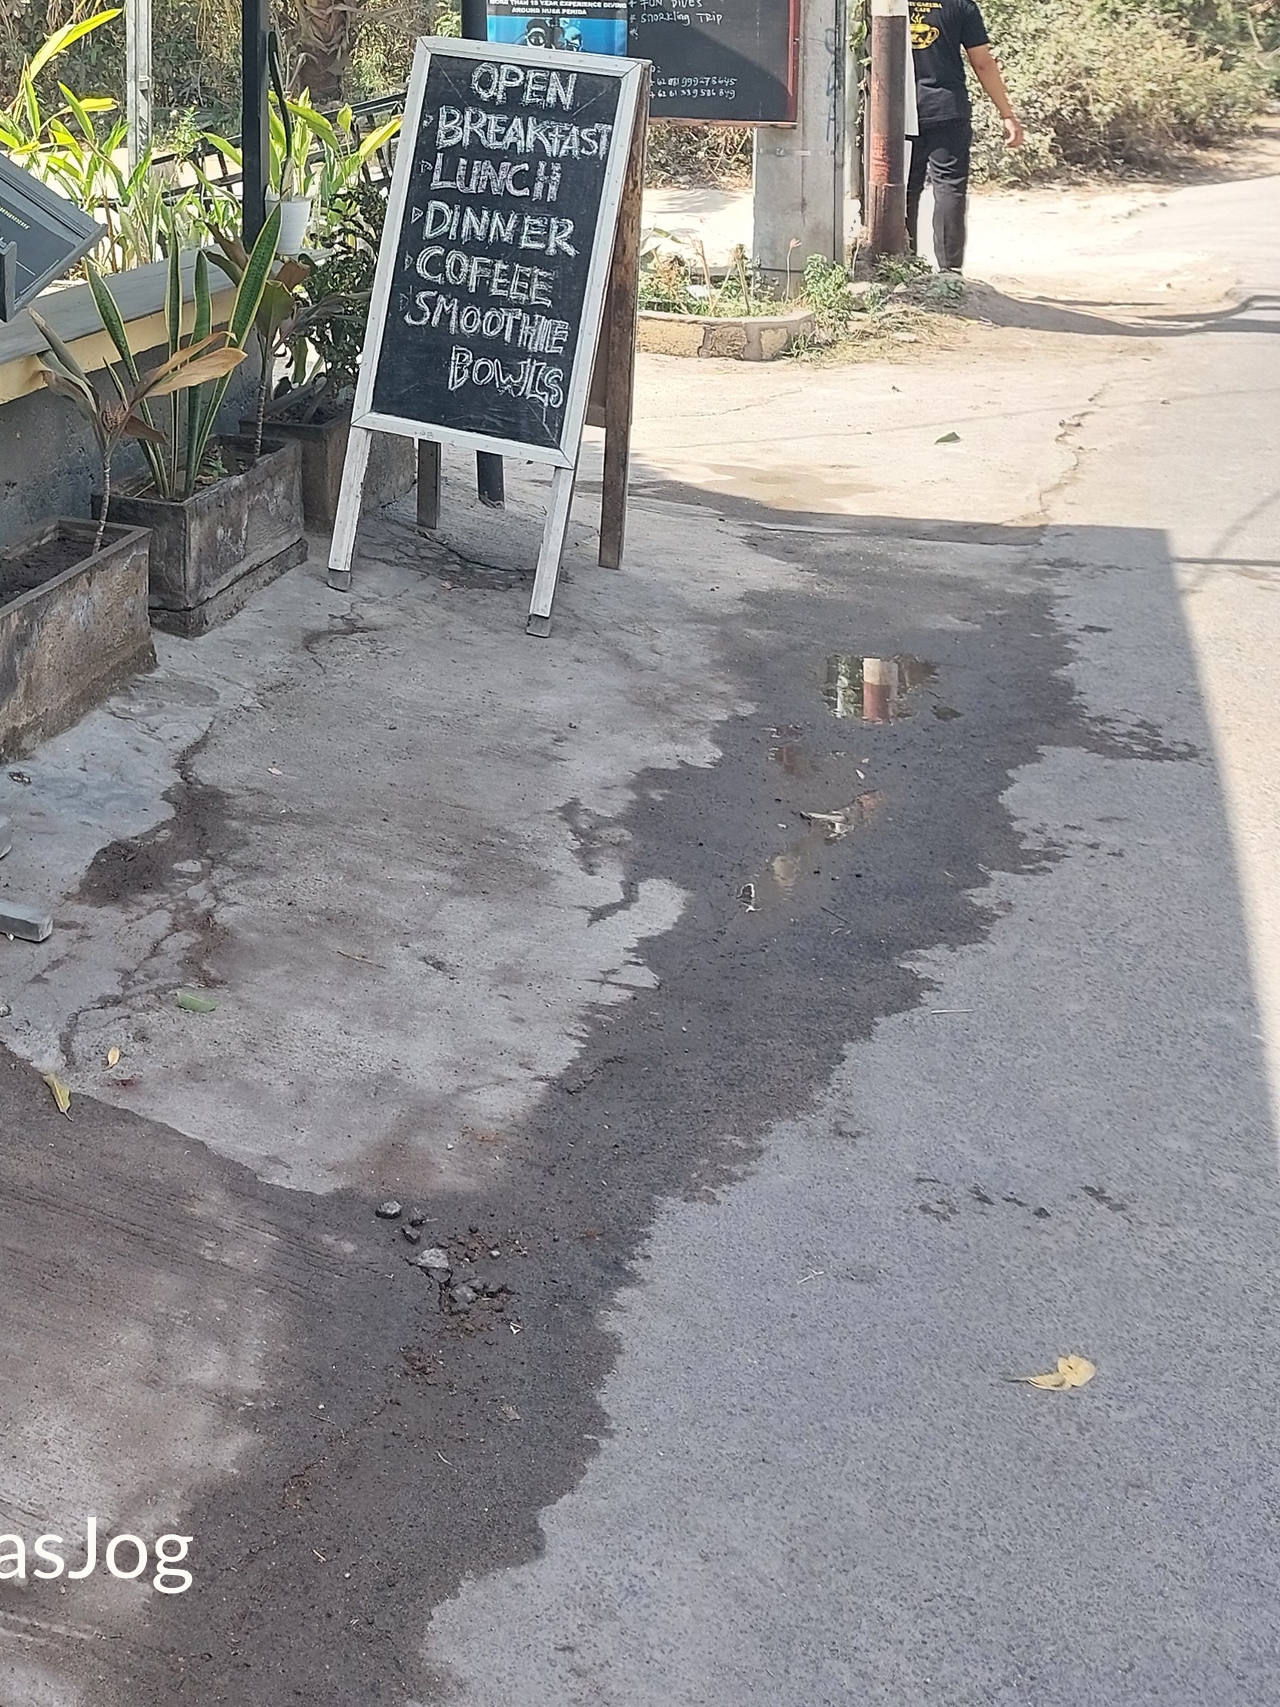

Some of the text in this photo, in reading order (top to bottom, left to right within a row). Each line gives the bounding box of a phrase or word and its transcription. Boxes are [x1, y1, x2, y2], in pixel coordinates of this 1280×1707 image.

[470, 62, 578, 111] OPEN
[435, 103, 614, 161] BREAKFAST
[429, 152, 564, 202] LUNCH
[422, 199, 581, 259] DINNER
[402, 289, 572, 355] SMOOTHIE
